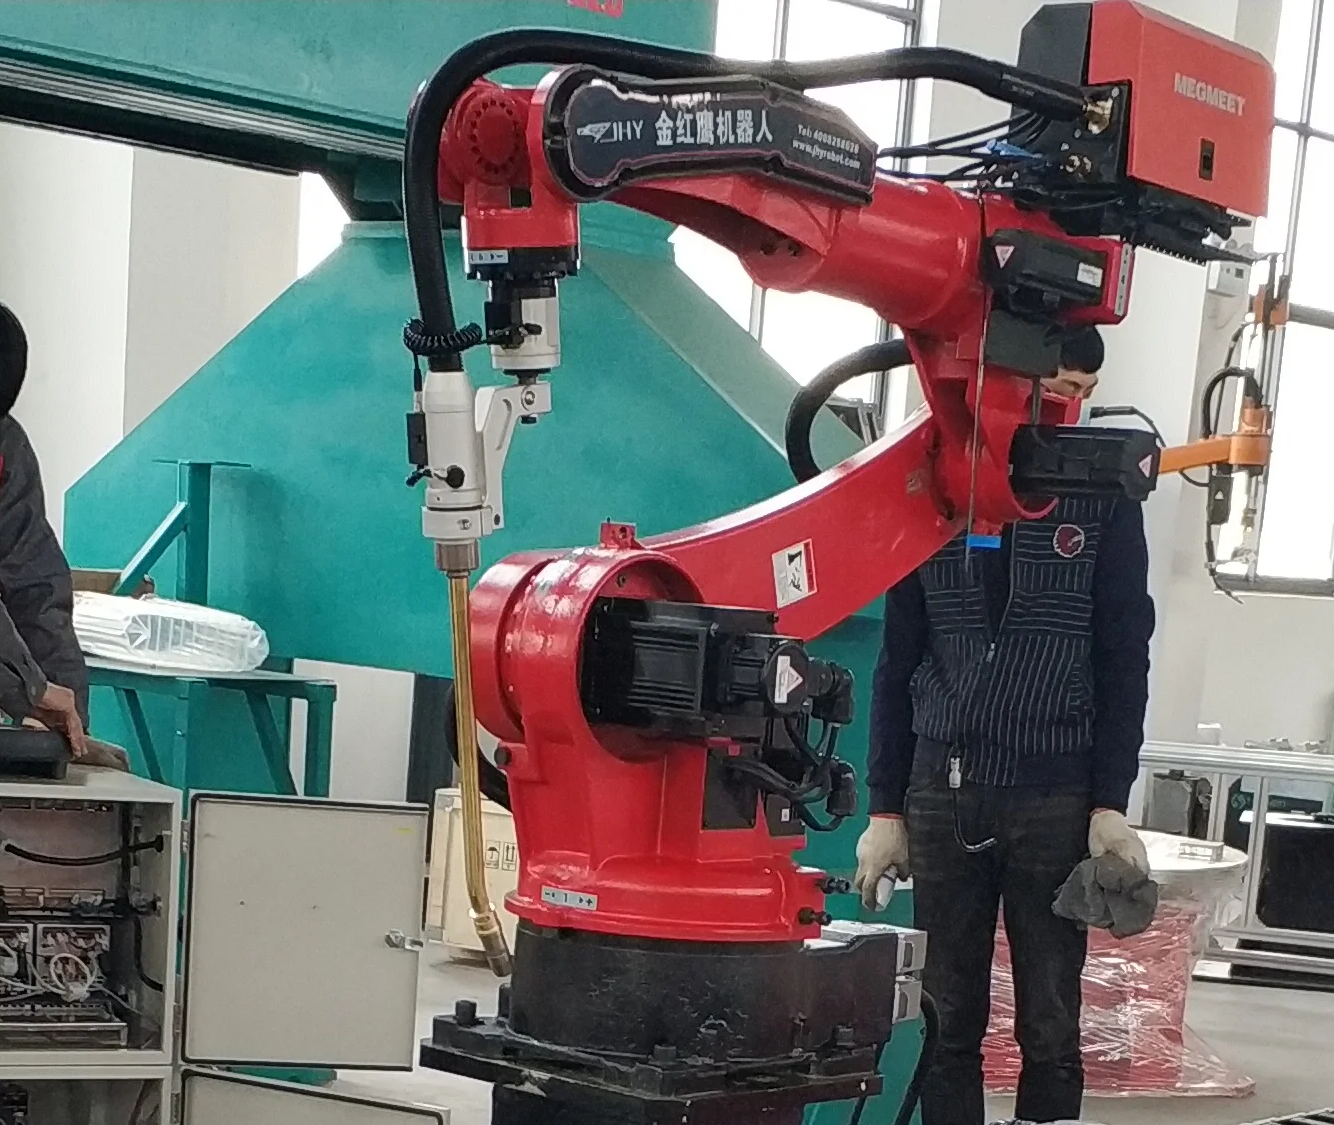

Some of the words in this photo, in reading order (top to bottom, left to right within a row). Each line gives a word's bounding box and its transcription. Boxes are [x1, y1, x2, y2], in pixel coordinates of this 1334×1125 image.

[1174, 71, 1246, 117] MEGMEET
[655, 108, 773, 146] 金红鹰机器人
